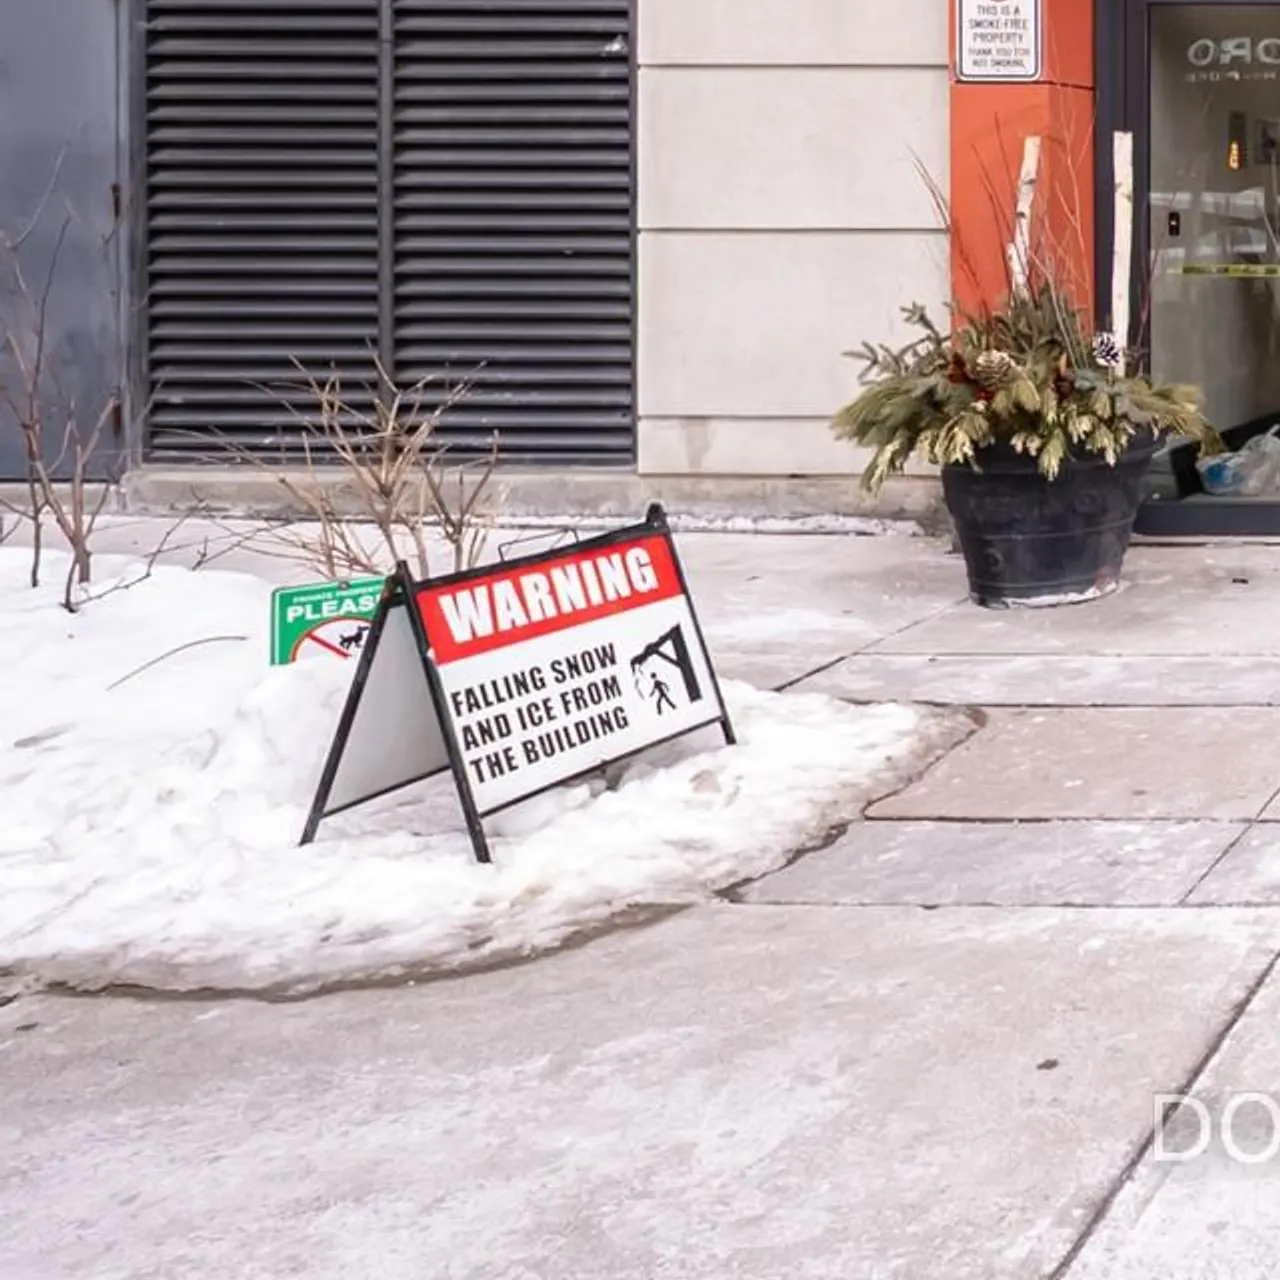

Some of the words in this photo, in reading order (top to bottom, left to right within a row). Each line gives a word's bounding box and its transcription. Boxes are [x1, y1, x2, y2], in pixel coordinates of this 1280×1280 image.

[286, 594, 381, 624] PLEAS
[439, 546, 659, 644] WARNING
[451, 666, 546, 717] FALLING
[550, 642, 617, 684] SNOW
[462, 713, 512, 751] AND
[516, 696, 557, 731] ICE
[560, 675, 623, 716] FROM
[470, 746, 519, 784] THE
[521, 706, 629, 765] BUILDING
